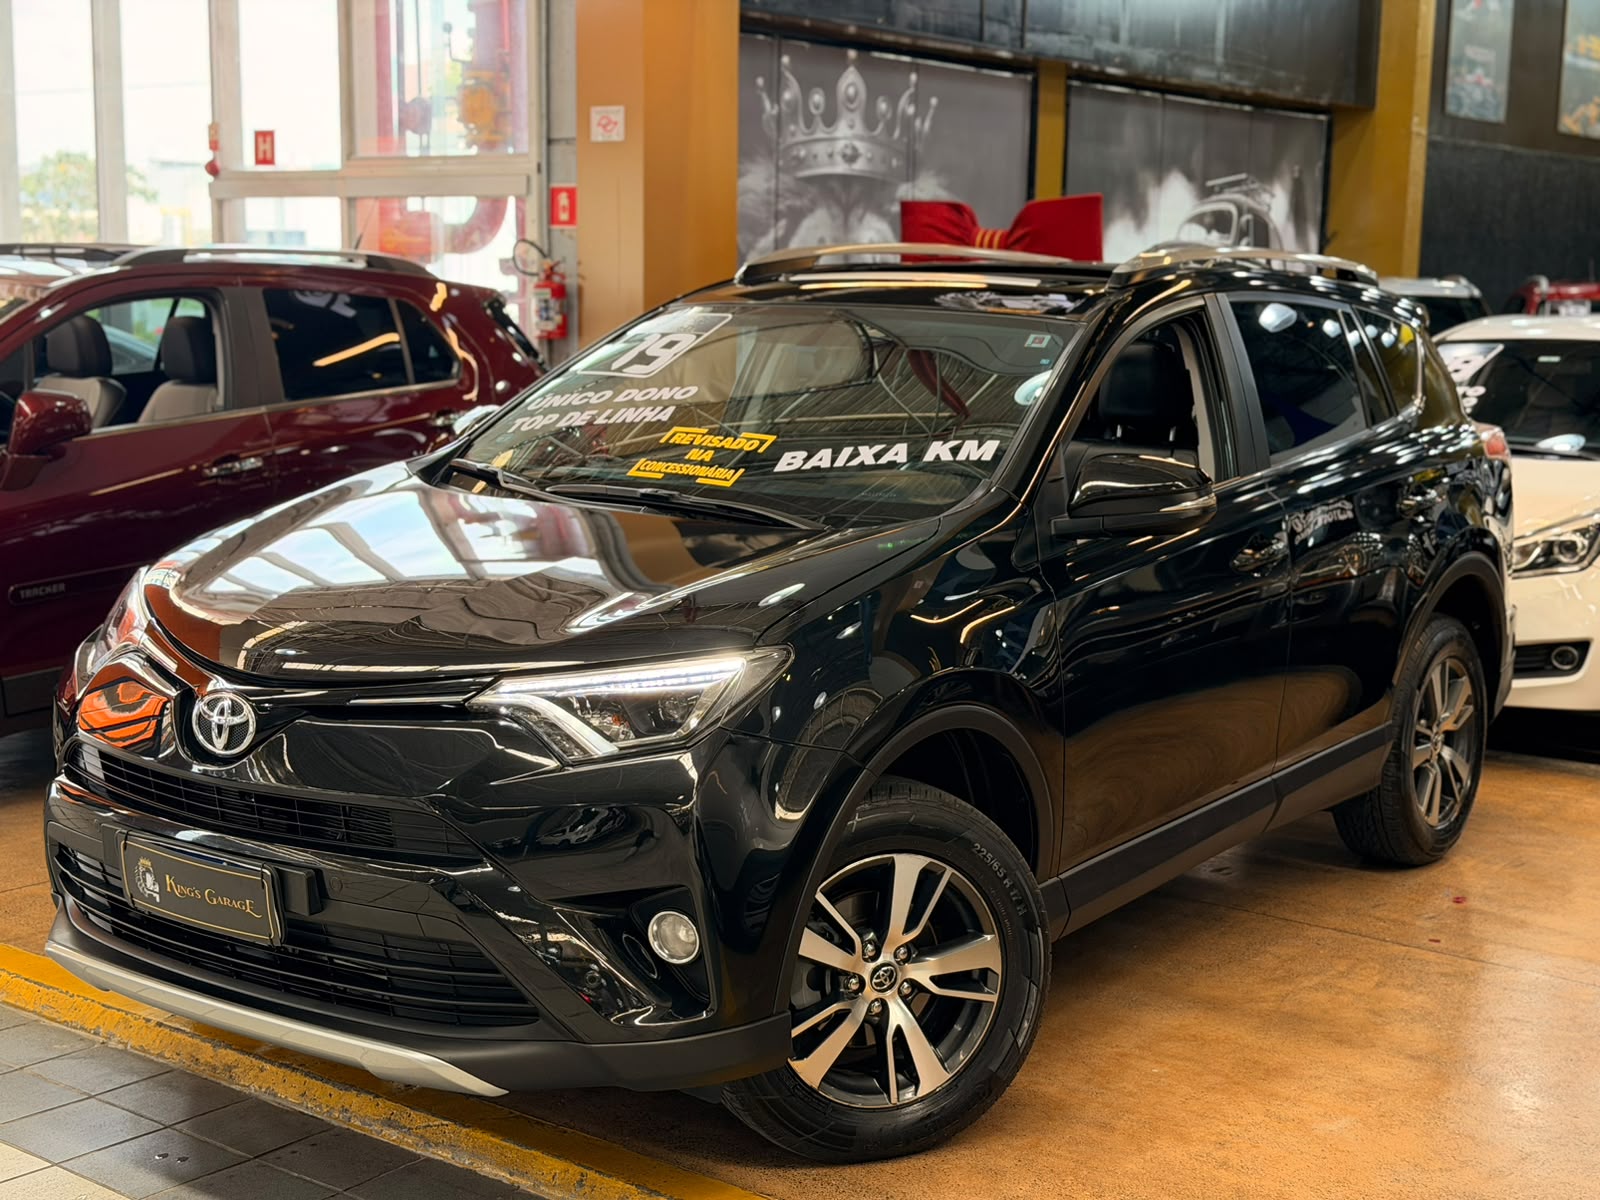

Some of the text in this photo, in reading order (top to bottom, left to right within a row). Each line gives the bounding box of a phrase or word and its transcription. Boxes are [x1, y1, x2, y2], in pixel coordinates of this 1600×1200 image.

[257, 135, 273, 160] H
[611, 332, 698, 374] 19
[527, 385, 699, 411] ÚNICO DONO
[507, 405, 677, 433] TOP DE LINHA
[669, 432, 761, 452] REVISADO
[684, 448, 715, 462] NA
[773, 439, 1001, 472] BAIXA KM
[639, 460, 736, 480] CONCESSIONÁRIA
